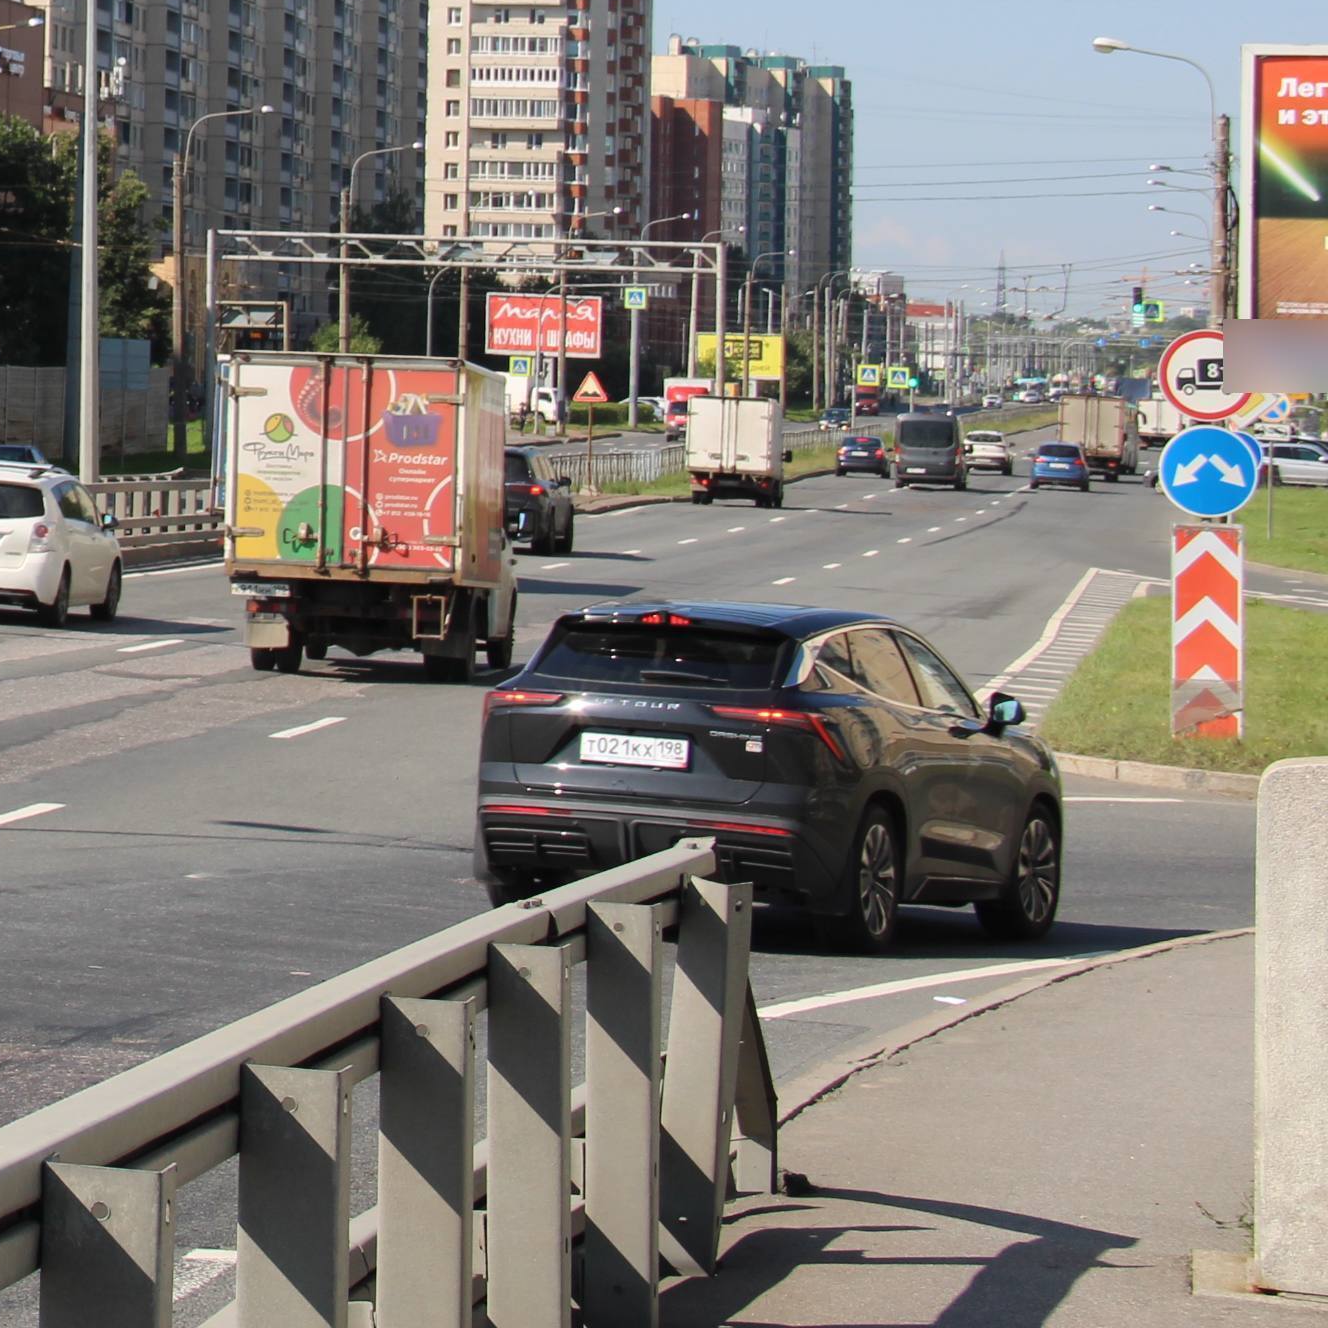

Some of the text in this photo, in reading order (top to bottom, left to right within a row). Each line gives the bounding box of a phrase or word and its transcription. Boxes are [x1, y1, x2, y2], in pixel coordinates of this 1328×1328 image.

[1278, 109, 1296, 125] и
[493, 327, 532, 346] КУХНИ
[547, 329, 595, 349] ШАФЫ
[388, 452, 448, 466] Prodstar
[658, 741, 684, 755] 198
